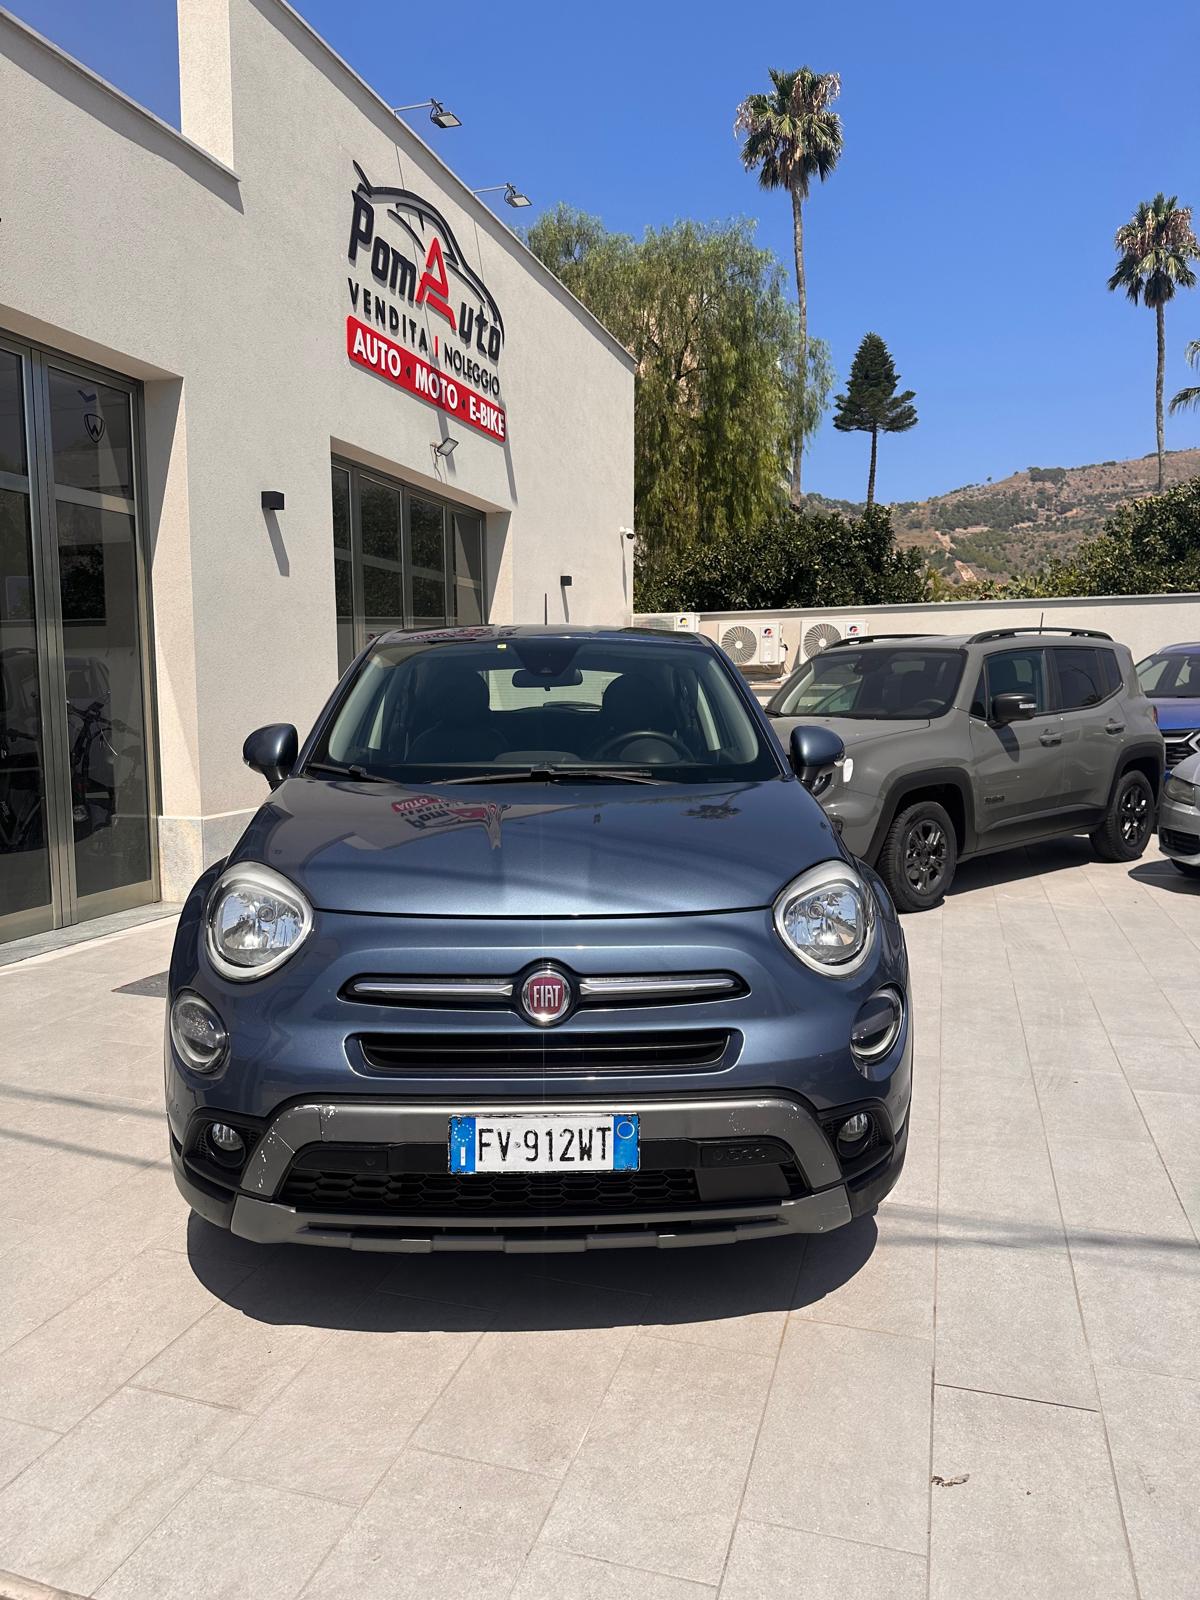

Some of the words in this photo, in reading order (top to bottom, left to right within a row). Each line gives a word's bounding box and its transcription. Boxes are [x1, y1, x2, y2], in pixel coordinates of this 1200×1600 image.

[348, 278, 428, 352] VENDITA
[444, 342, 500, 396] NOLEGGIO
[353, 328, 401, 377] AUTO
[415, 363, 458, 410] MOTO
[469, 395, 505, 437] E-BIKE
[533, 985, 561, 1008] FIAT
